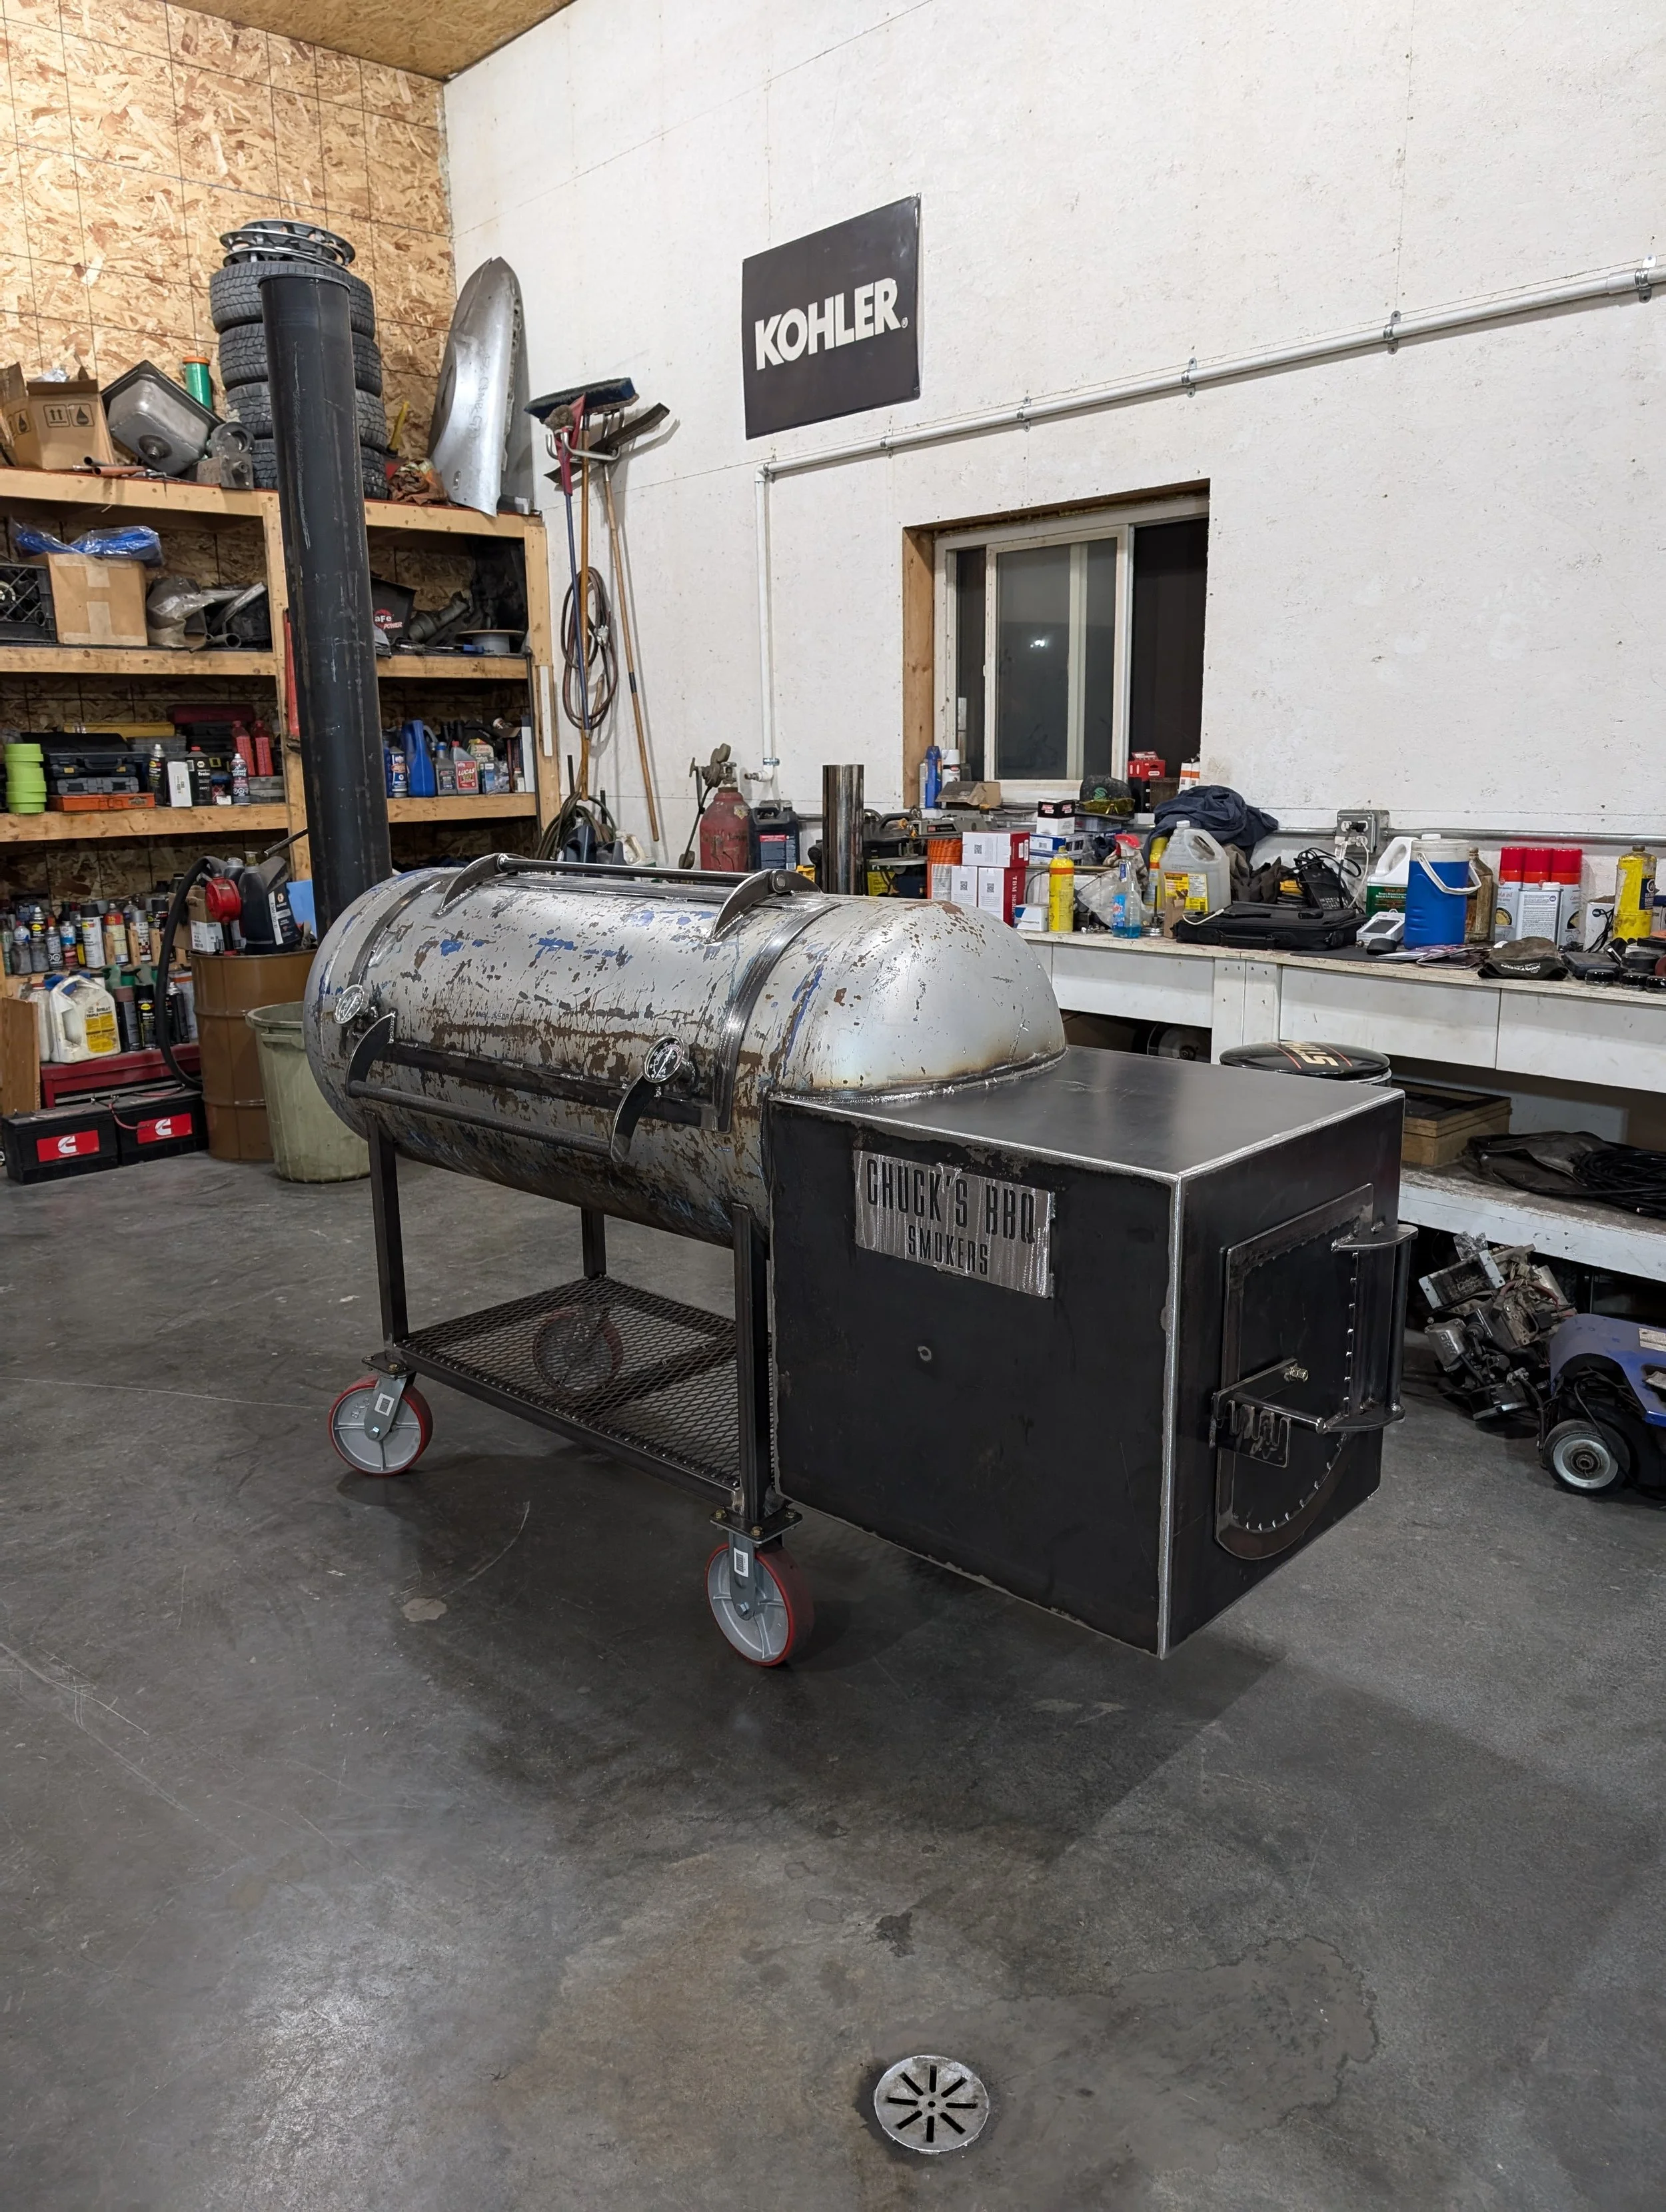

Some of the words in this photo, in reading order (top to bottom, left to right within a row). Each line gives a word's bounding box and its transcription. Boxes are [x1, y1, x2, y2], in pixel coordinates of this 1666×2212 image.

[755, 277, 902, 371] KOHLER
[383, 621, 403, 630] POWER
[458, 768, 475, 776] LUCAS
[866, 1159, 968, 1228] CHUCK'S
[986, 1184, 1036, 1244] BBQ
[908, 1225, 988, 1276] SMOKERS
